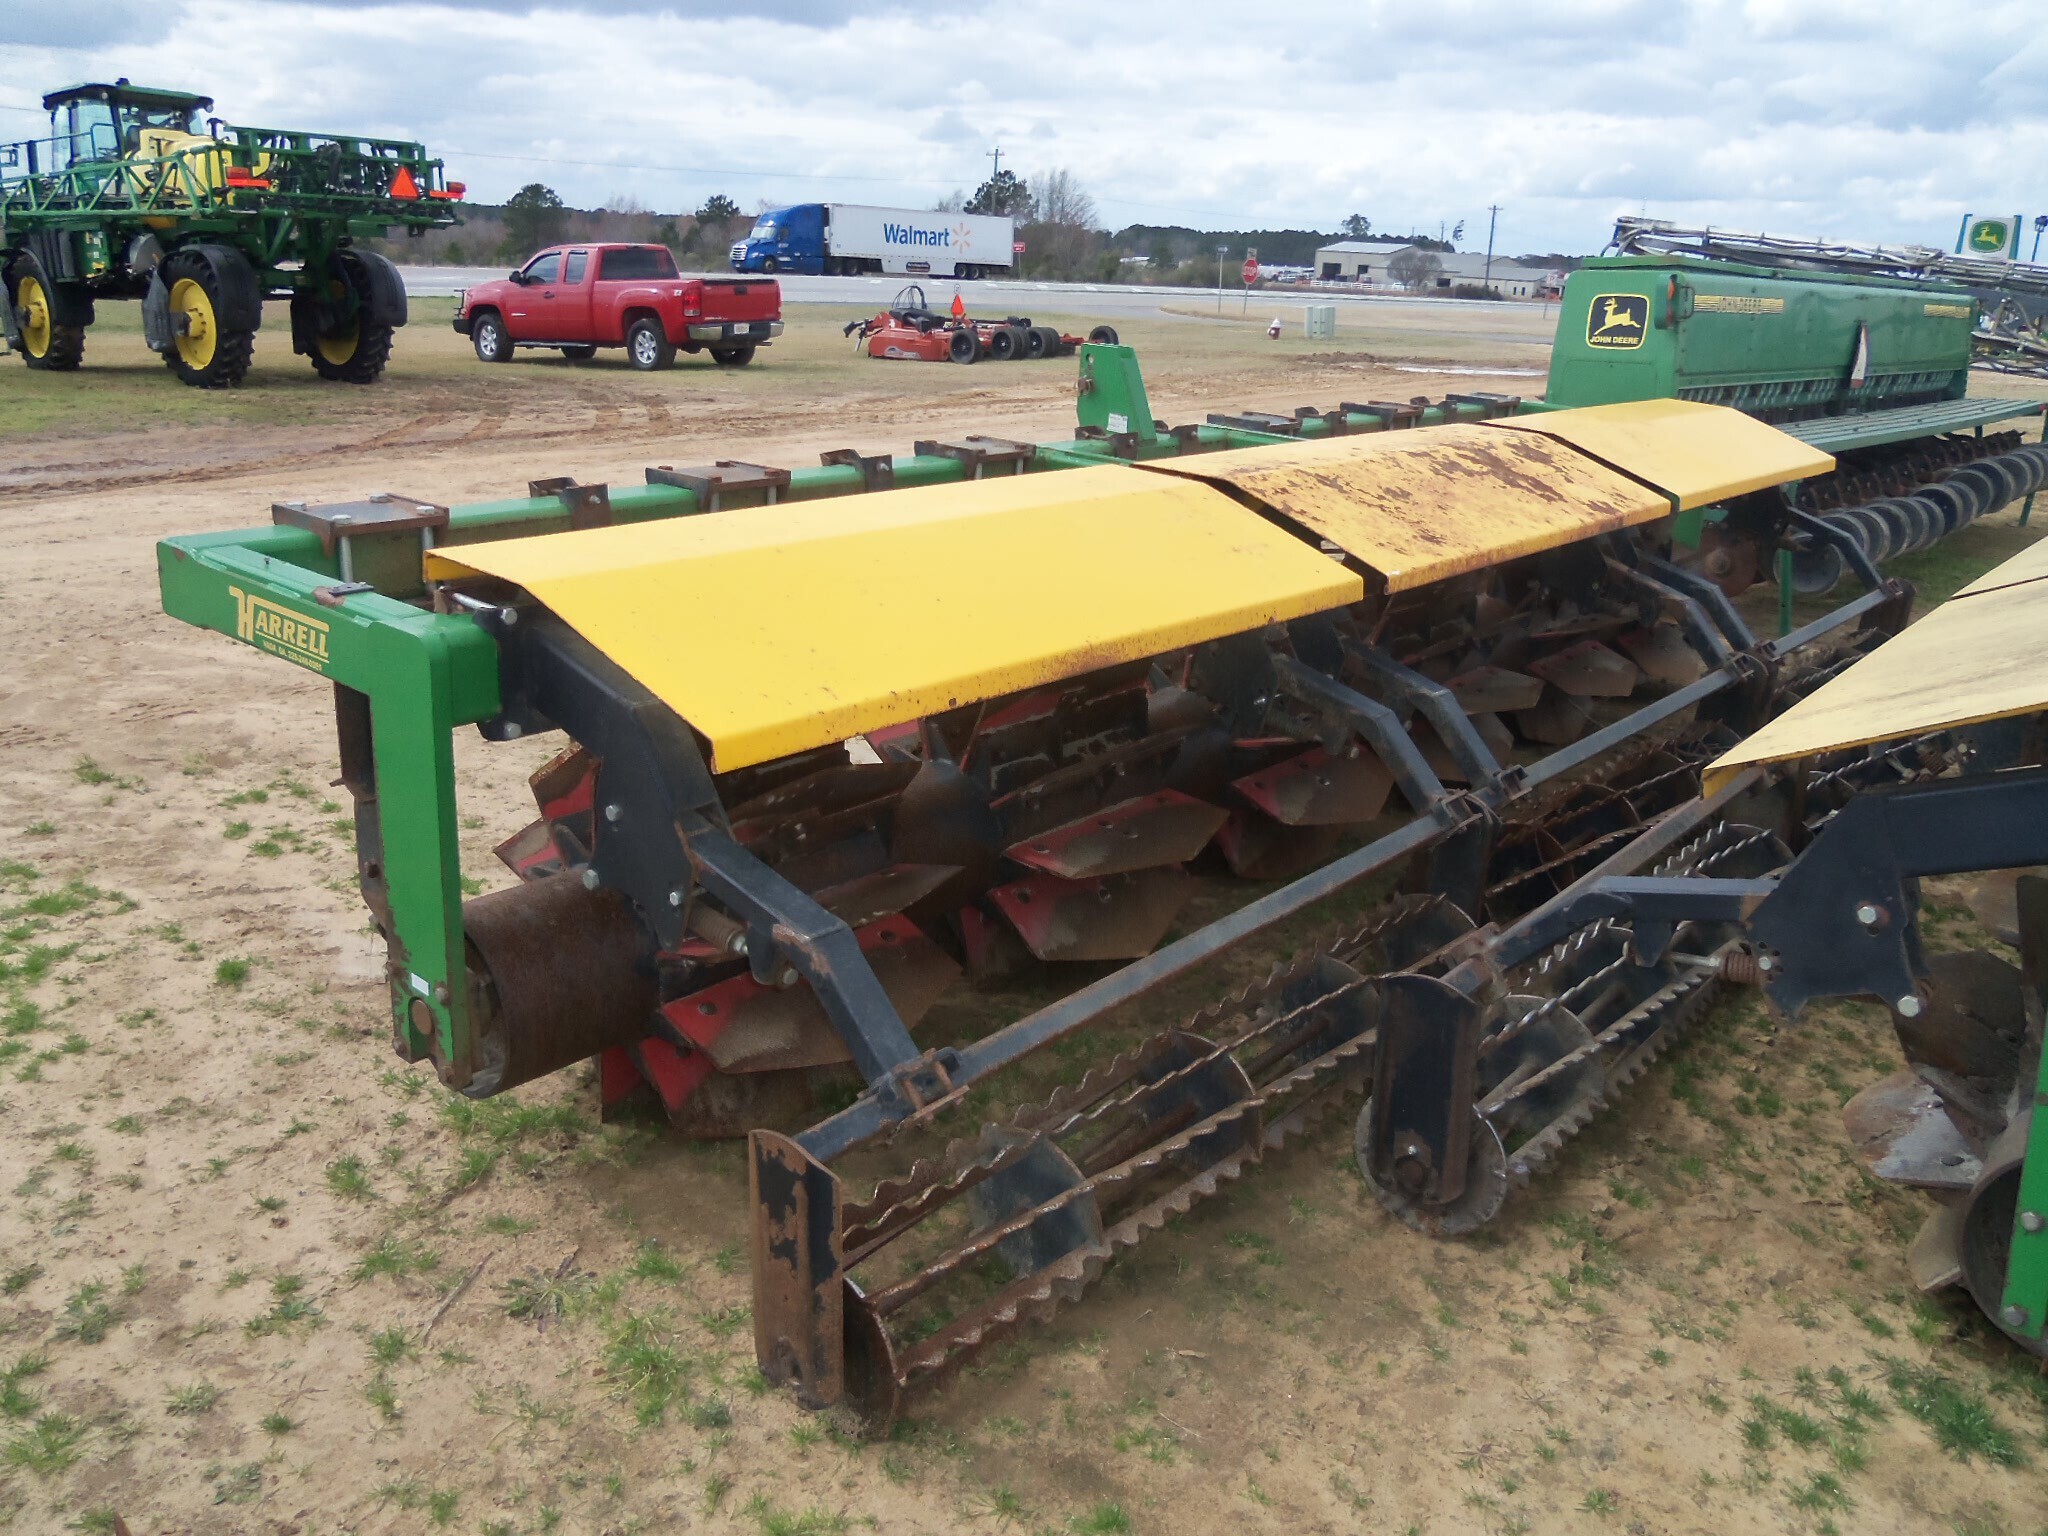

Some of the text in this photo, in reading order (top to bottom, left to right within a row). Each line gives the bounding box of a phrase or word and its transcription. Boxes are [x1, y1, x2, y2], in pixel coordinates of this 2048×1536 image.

[883, 222, 950, 247] Walmart
[1590, 335, 1640, 345] JOHN DEERE
[228, 584, 330, 659] HARRELL
